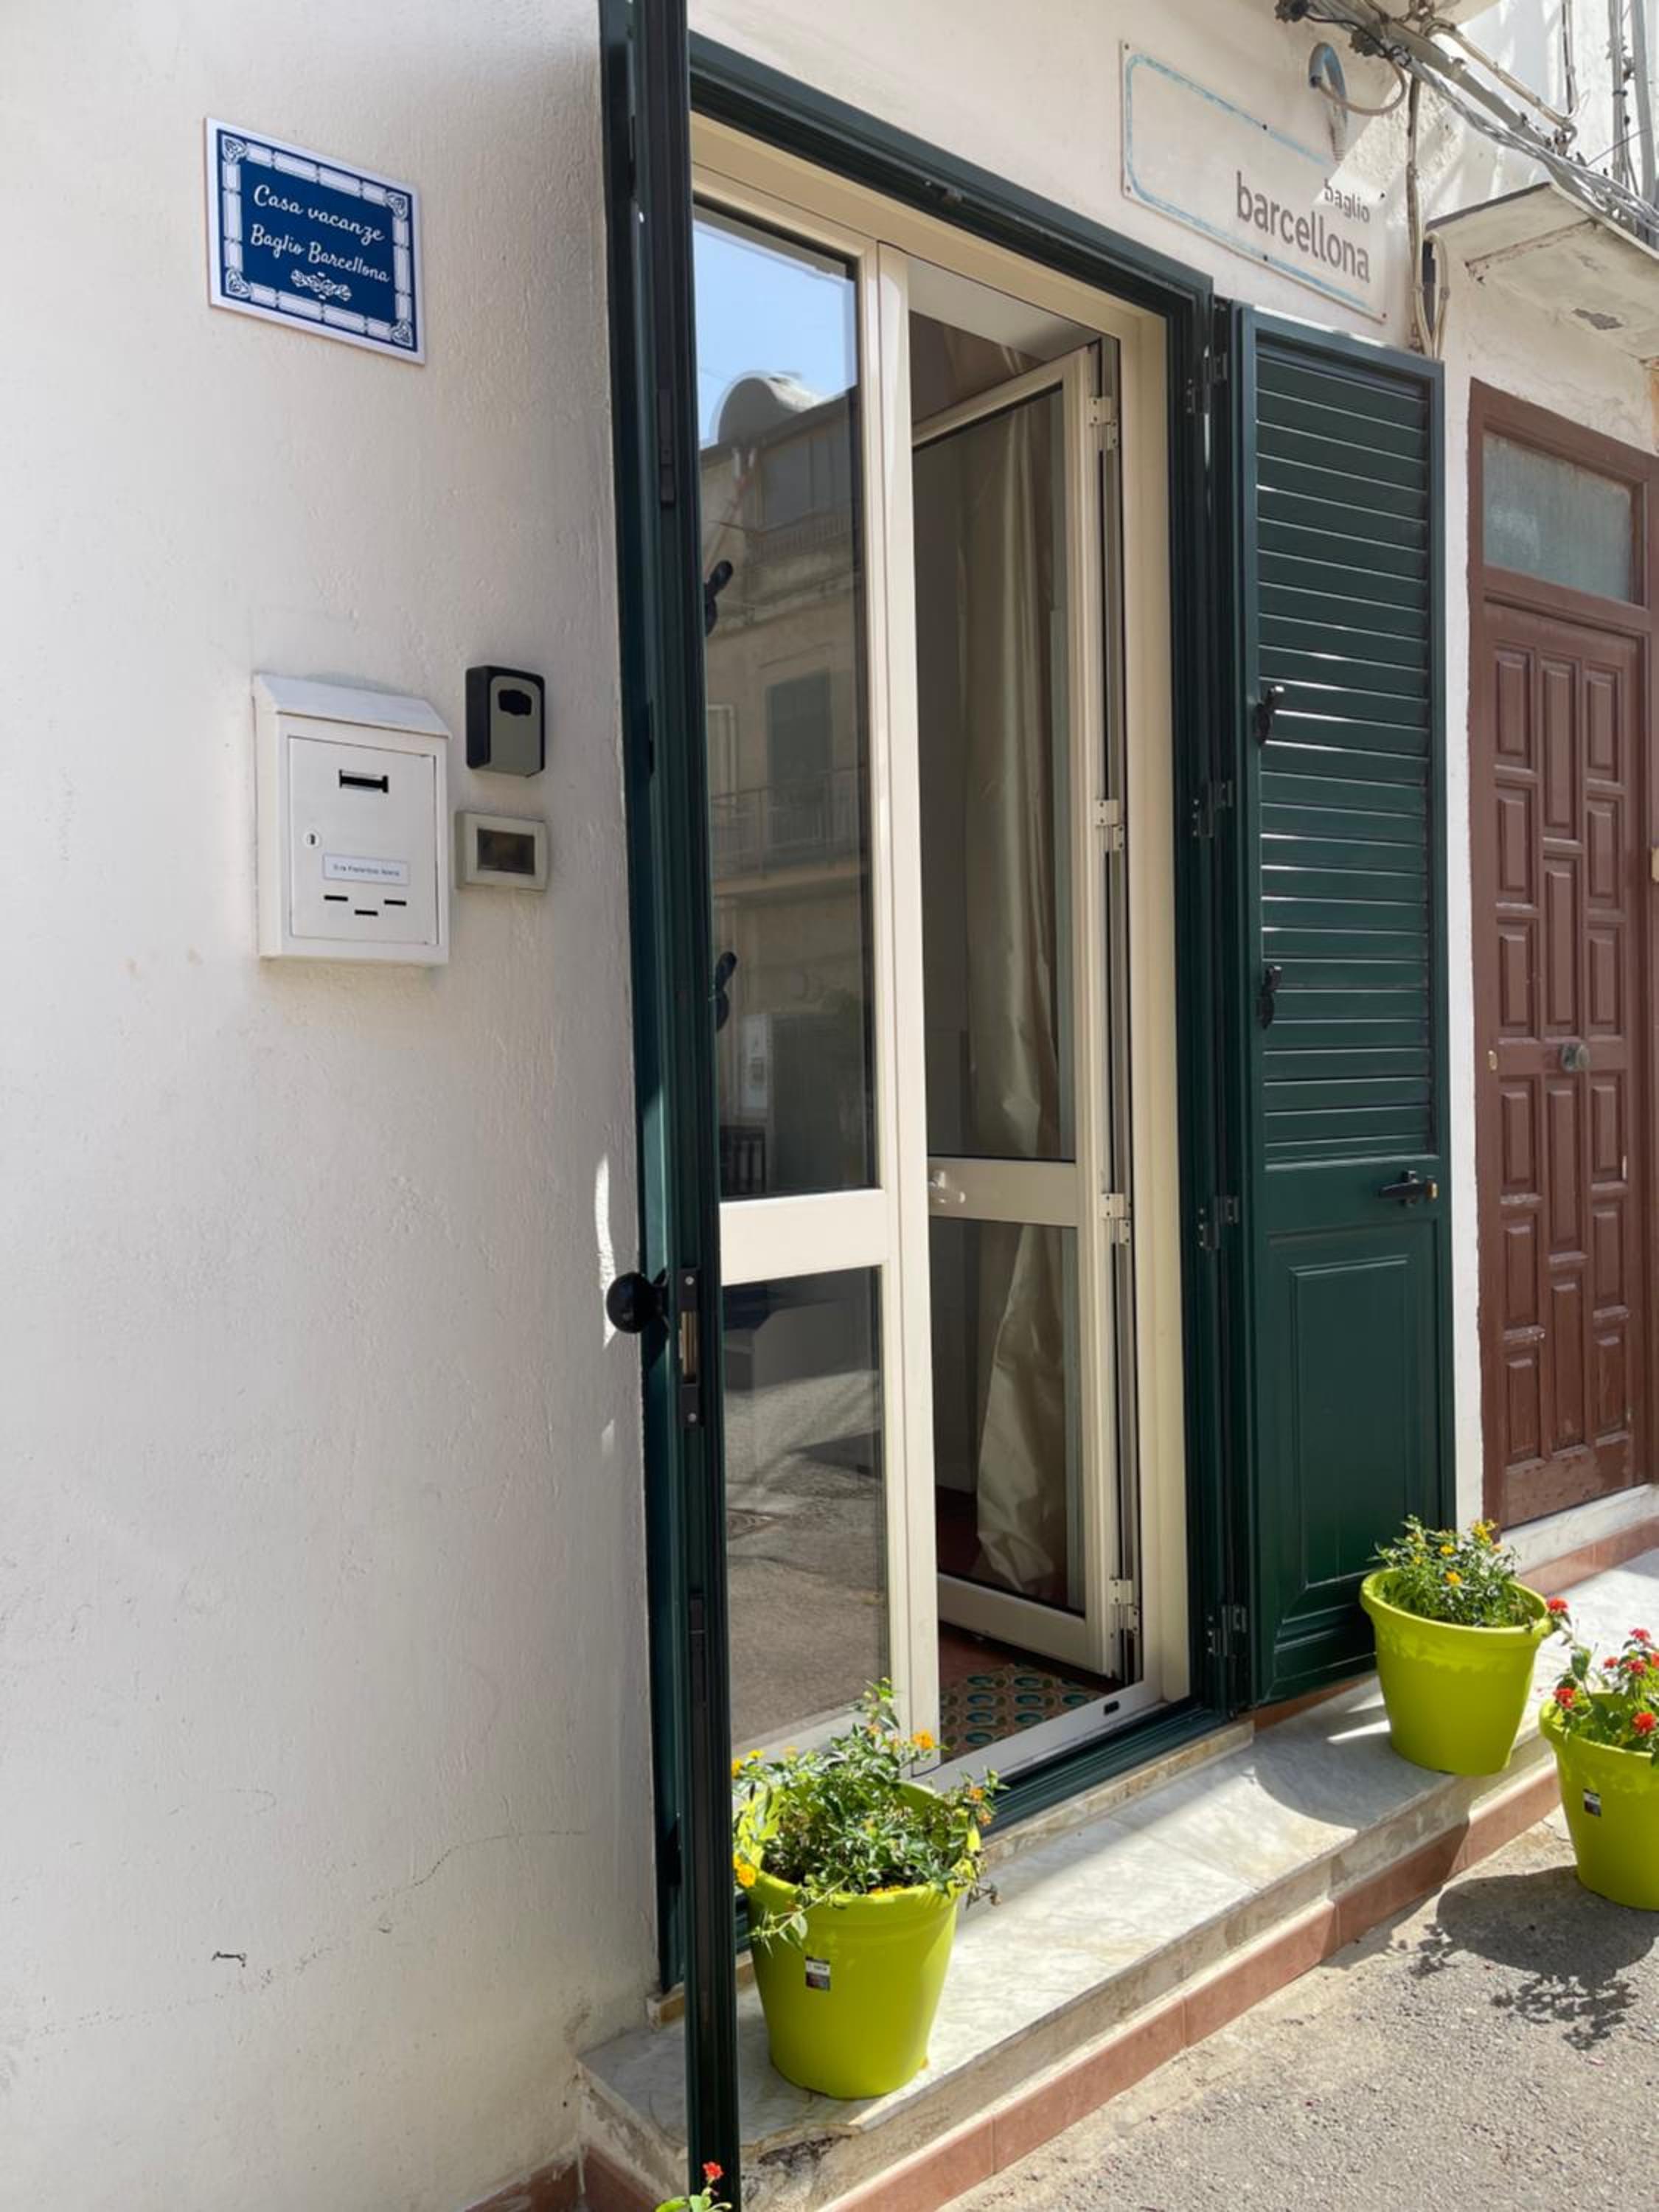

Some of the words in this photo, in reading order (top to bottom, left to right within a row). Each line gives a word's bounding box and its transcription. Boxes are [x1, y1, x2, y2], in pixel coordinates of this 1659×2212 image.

[254, 184, 304, 215] Casa
[307, 207, 385, 246] vacanze
[1237, 170, 1370, 283] barcellona
[1324, 177, 1371, 223] baglio
[250, 223, 305, 258] Baglio
[307, 241, 390, 282] Barcellona
